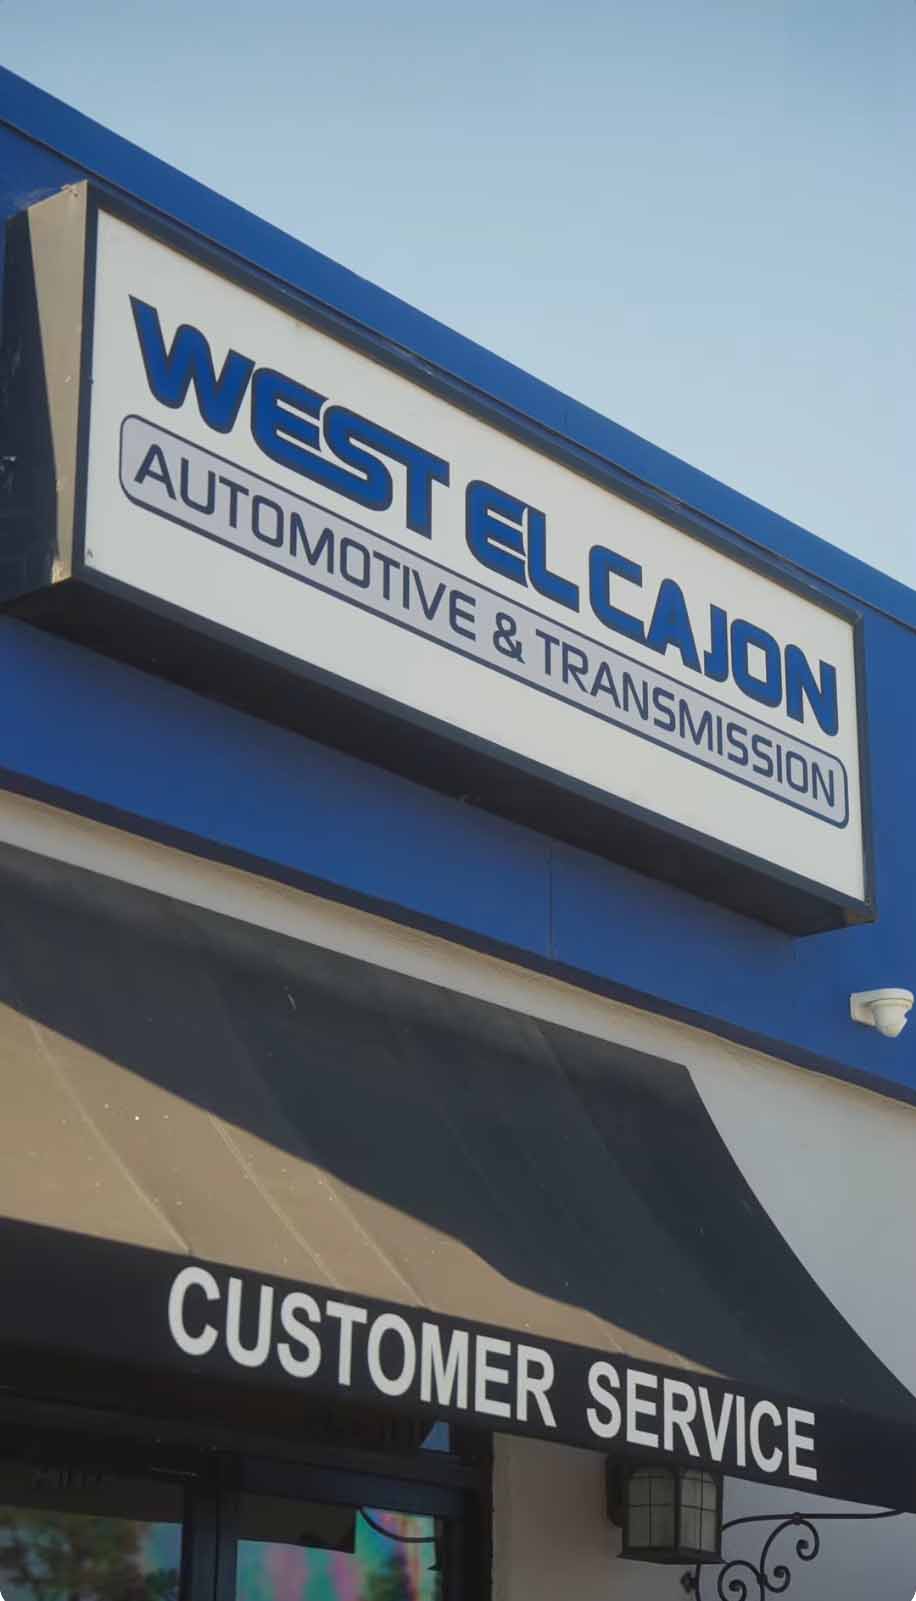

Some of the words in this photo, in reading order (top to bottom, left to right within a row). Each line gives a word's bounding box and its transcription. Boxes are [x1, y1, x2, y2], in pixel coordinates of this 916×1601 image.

[129, 294, 450, 540] WEST
[465, 479, 581, 613] EL
[588, 544, 840, 737] CAJON
[133, 443, 477, 641] AUTOMOTIVE
[493, 611, 526, 663] &
[535, 628, 836, 808] TRANSMISSION
[168, 1266, 556, 1428] CUSTOMER
[586, 1361, 818, 1481] SERVICE
